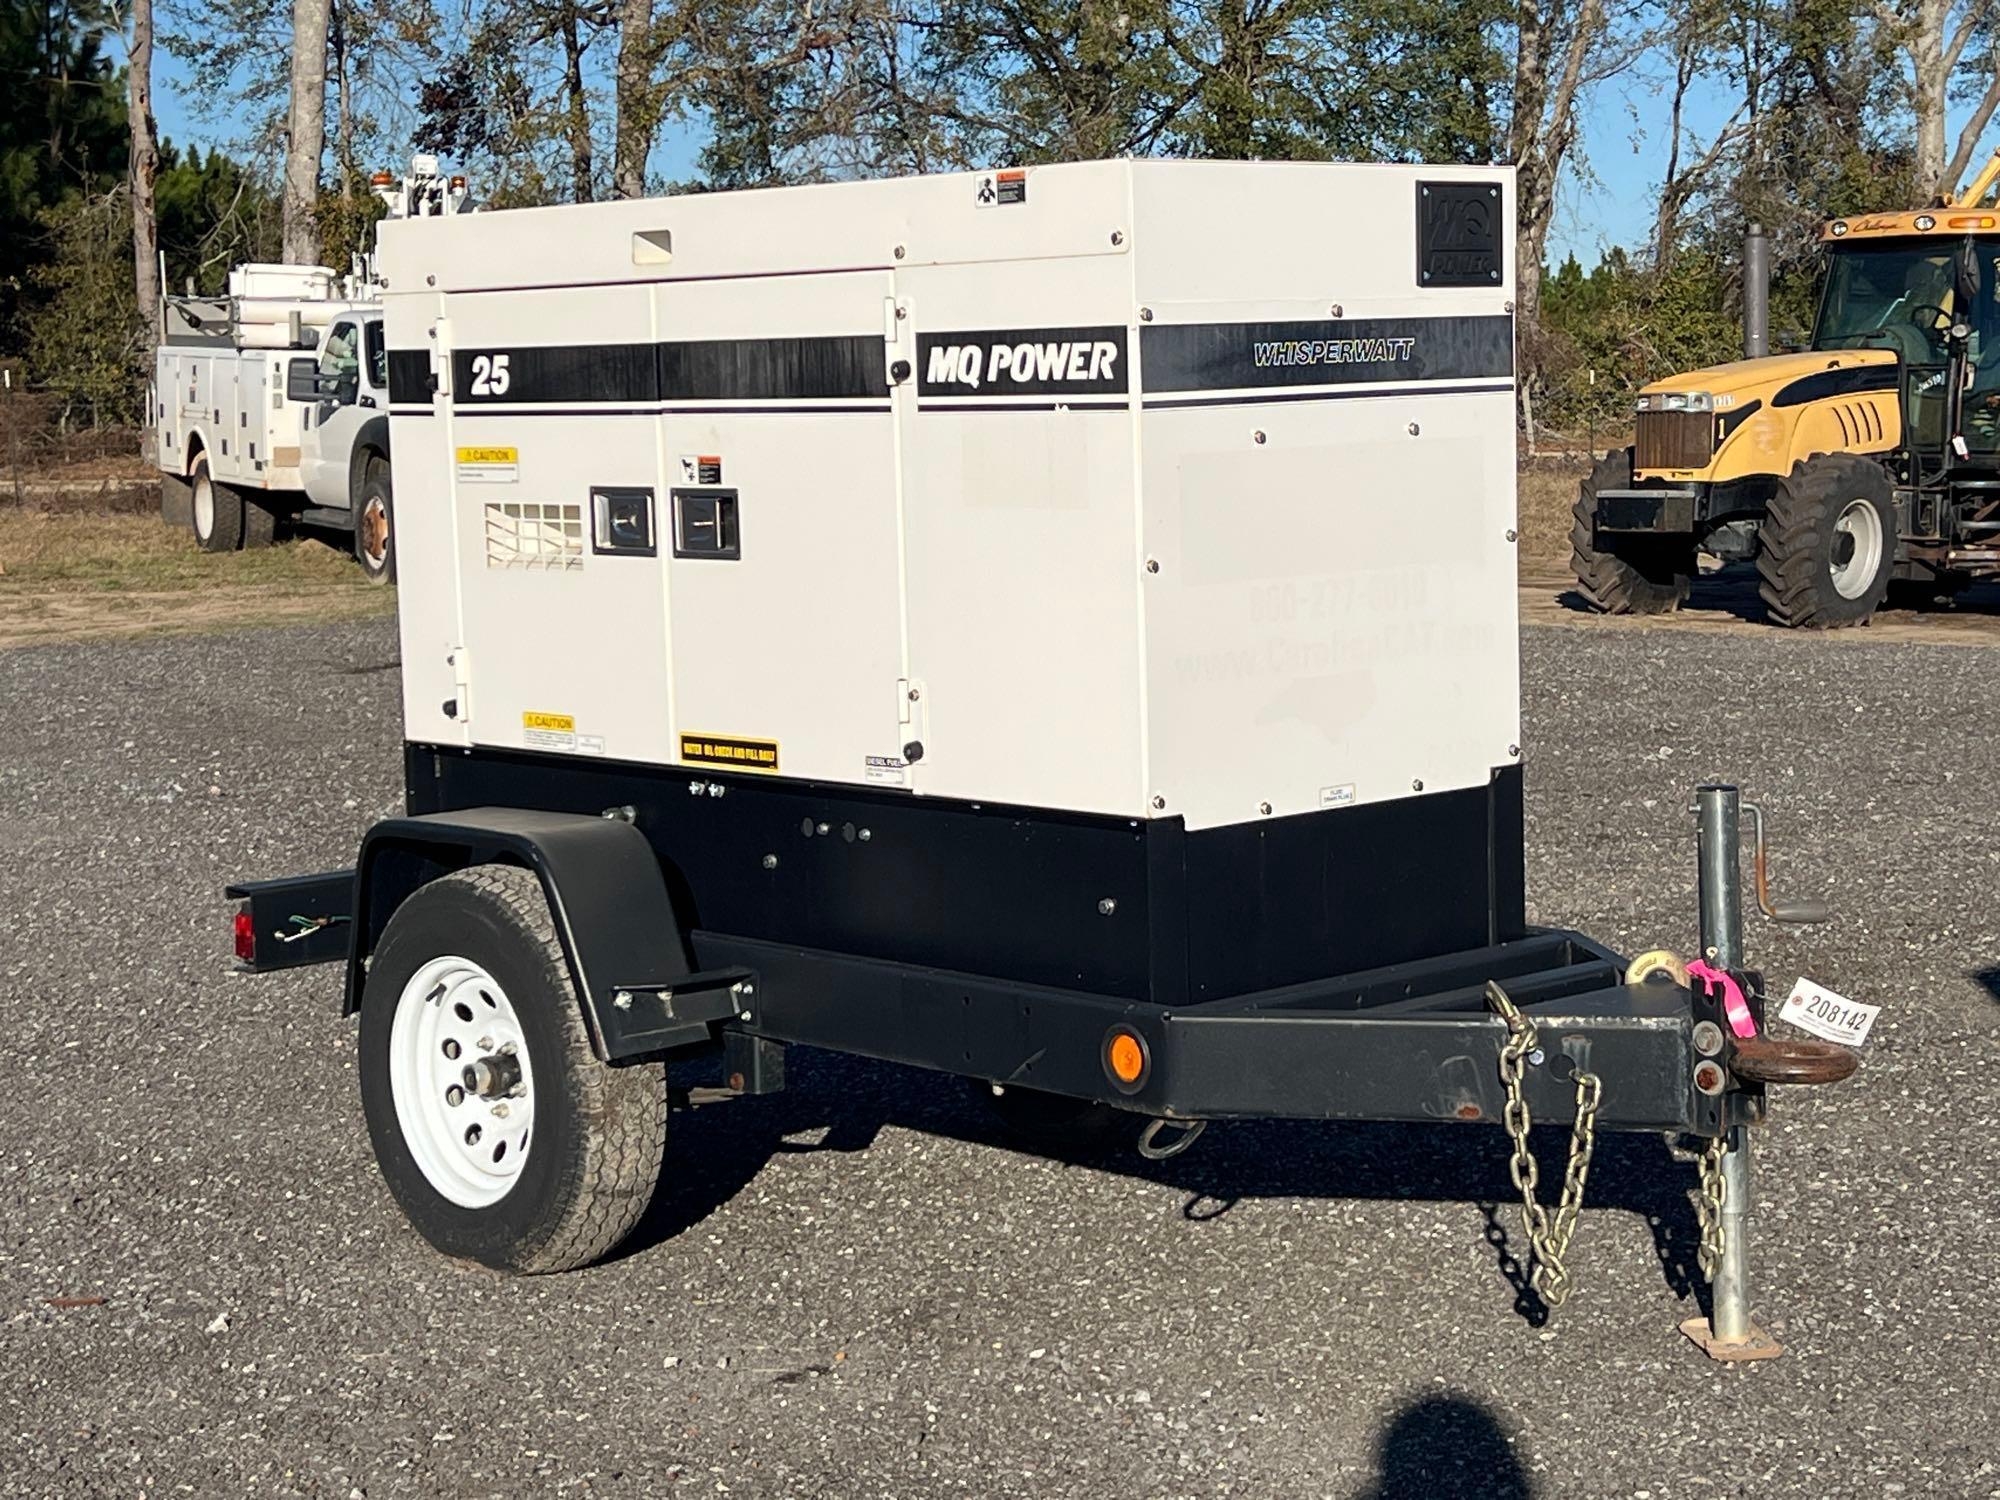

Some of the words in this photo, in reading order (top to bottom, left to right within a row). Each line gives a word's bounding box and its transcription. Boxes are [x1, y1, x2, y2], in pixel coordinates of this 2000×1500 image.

[926, 345, 983, 389] MQ
[986, 341, 1118, 383] POWER
[1254, 337, 1415, 367] WHISPERWATT
[471, 354, 510, 395] 25
[472, 450, 510, 461] CAUTION
[534, 715, 572, 729] CAUTION
[1806, 995, 1867, 1030] 208142
